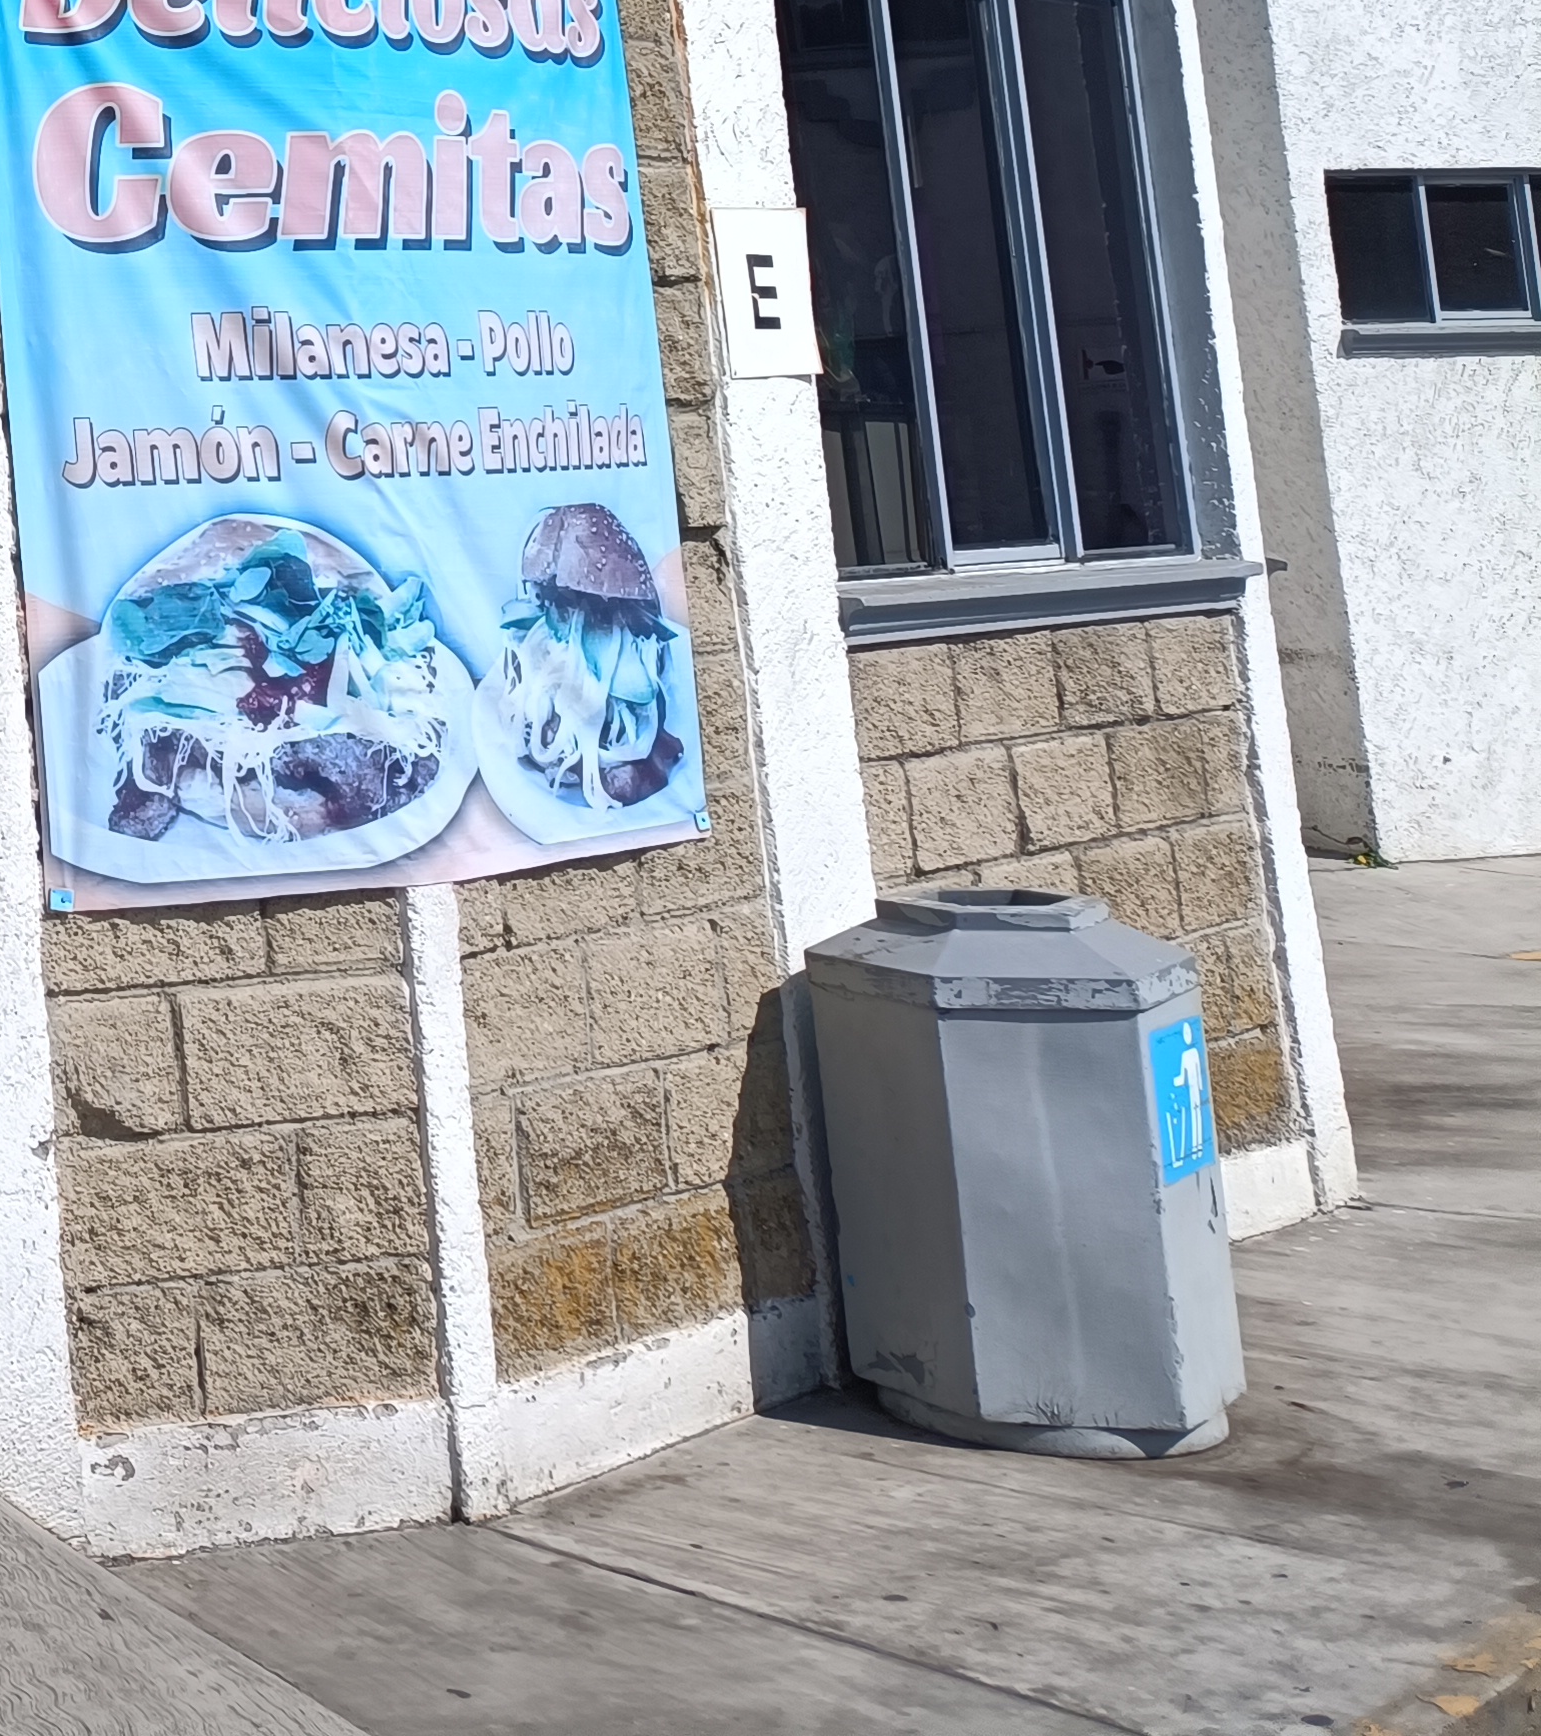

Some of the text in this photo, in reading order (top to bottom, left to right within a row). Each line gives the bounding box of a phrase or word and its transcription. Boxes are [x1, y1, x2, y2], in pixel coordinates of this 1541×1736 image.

[33, 82, 635, 254] Cemitas
[746, 254, 781, 329] E
[190, 306, 451, 382] Milanesa
[478, 310, 576, 376] Pollo
[62, 406, 282, 489] Jamón
[325, 410, 475, 480] Carne
[478, 402, 647, 474] Enchilada
